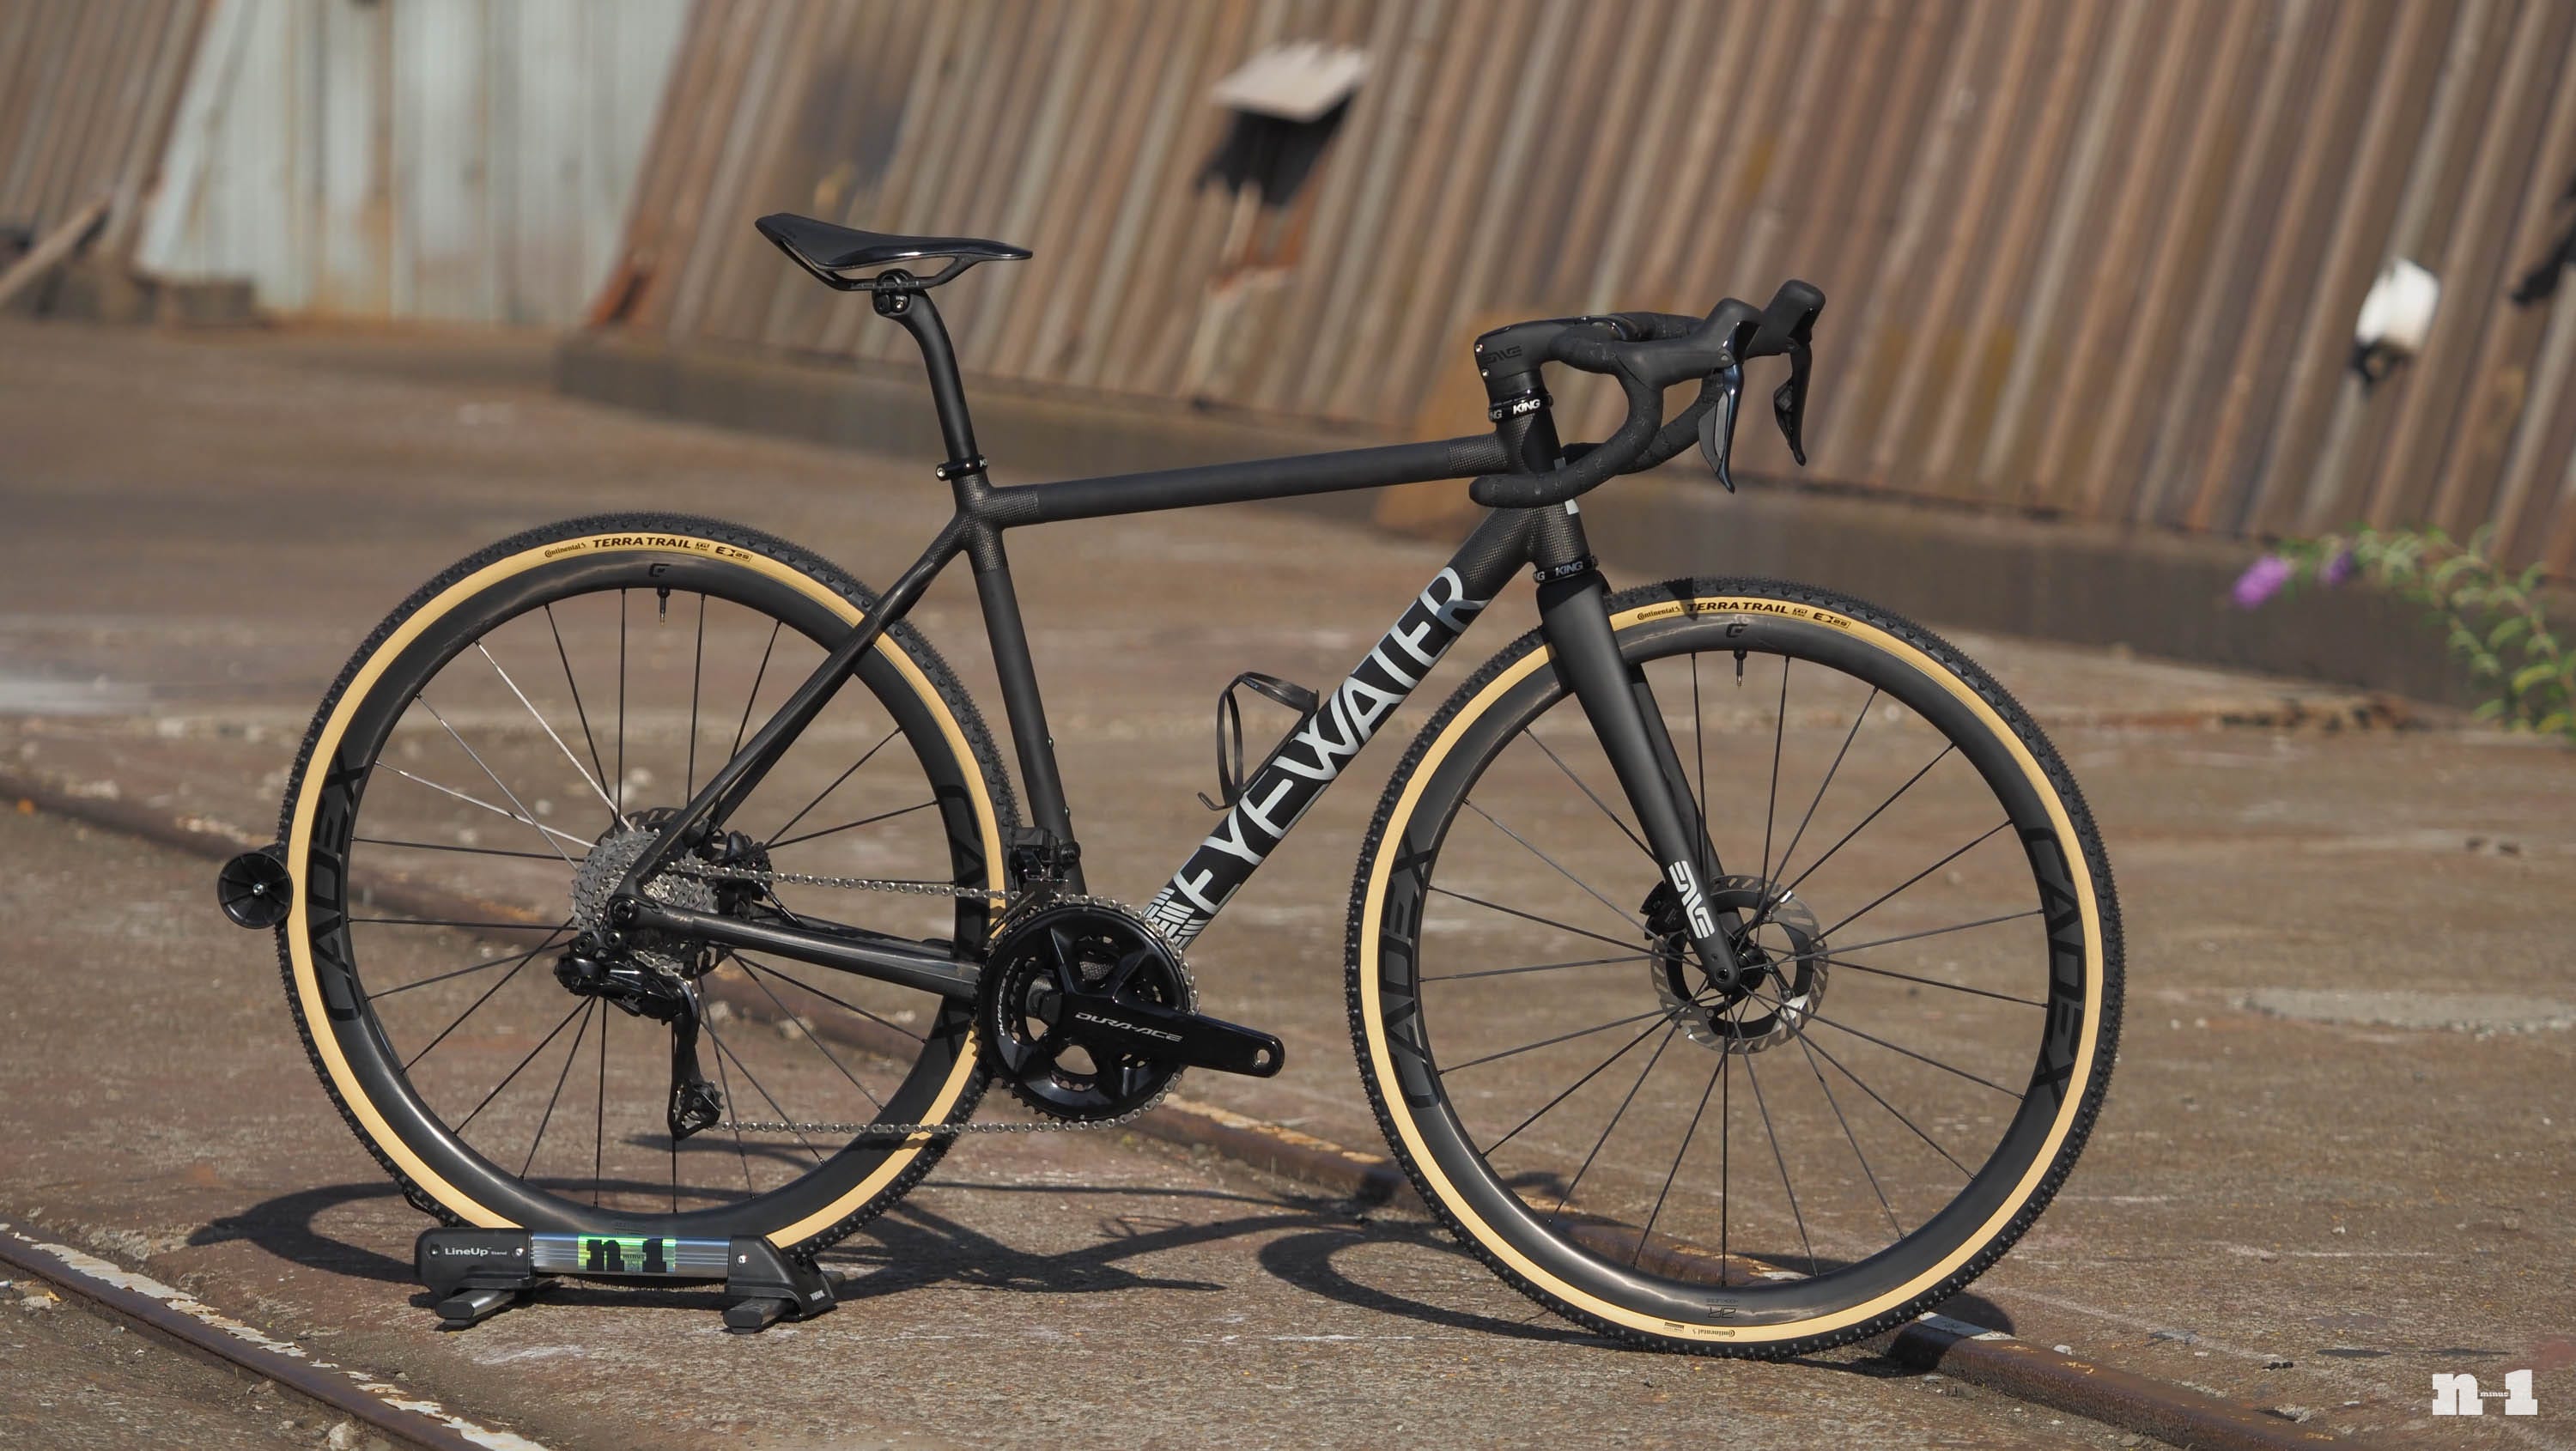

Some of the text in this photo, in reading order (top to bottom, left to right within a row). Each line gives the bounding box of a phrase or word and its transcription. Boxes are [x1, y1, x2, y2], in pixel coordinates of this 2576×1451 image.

[1512, 398, 1540, 415] KING
[544, 543, 581, 558] Continental
[592, 537, 643, 548] TERRA
[646, 537, 691, 549] TRAIL
[1637, 607, 1676, 621] Continental
[1687, 602, 1740, 612] TERRA
[1742, 602, 1788, 614] TRAIL
[1377, 828, 1440, 1108] CADEX
[2024, 828, 2085, 1111] CADEX
[1075, 1011, 1183, 1042] DURA-ACE
[445, 1248, 489, 1256] LineUp
